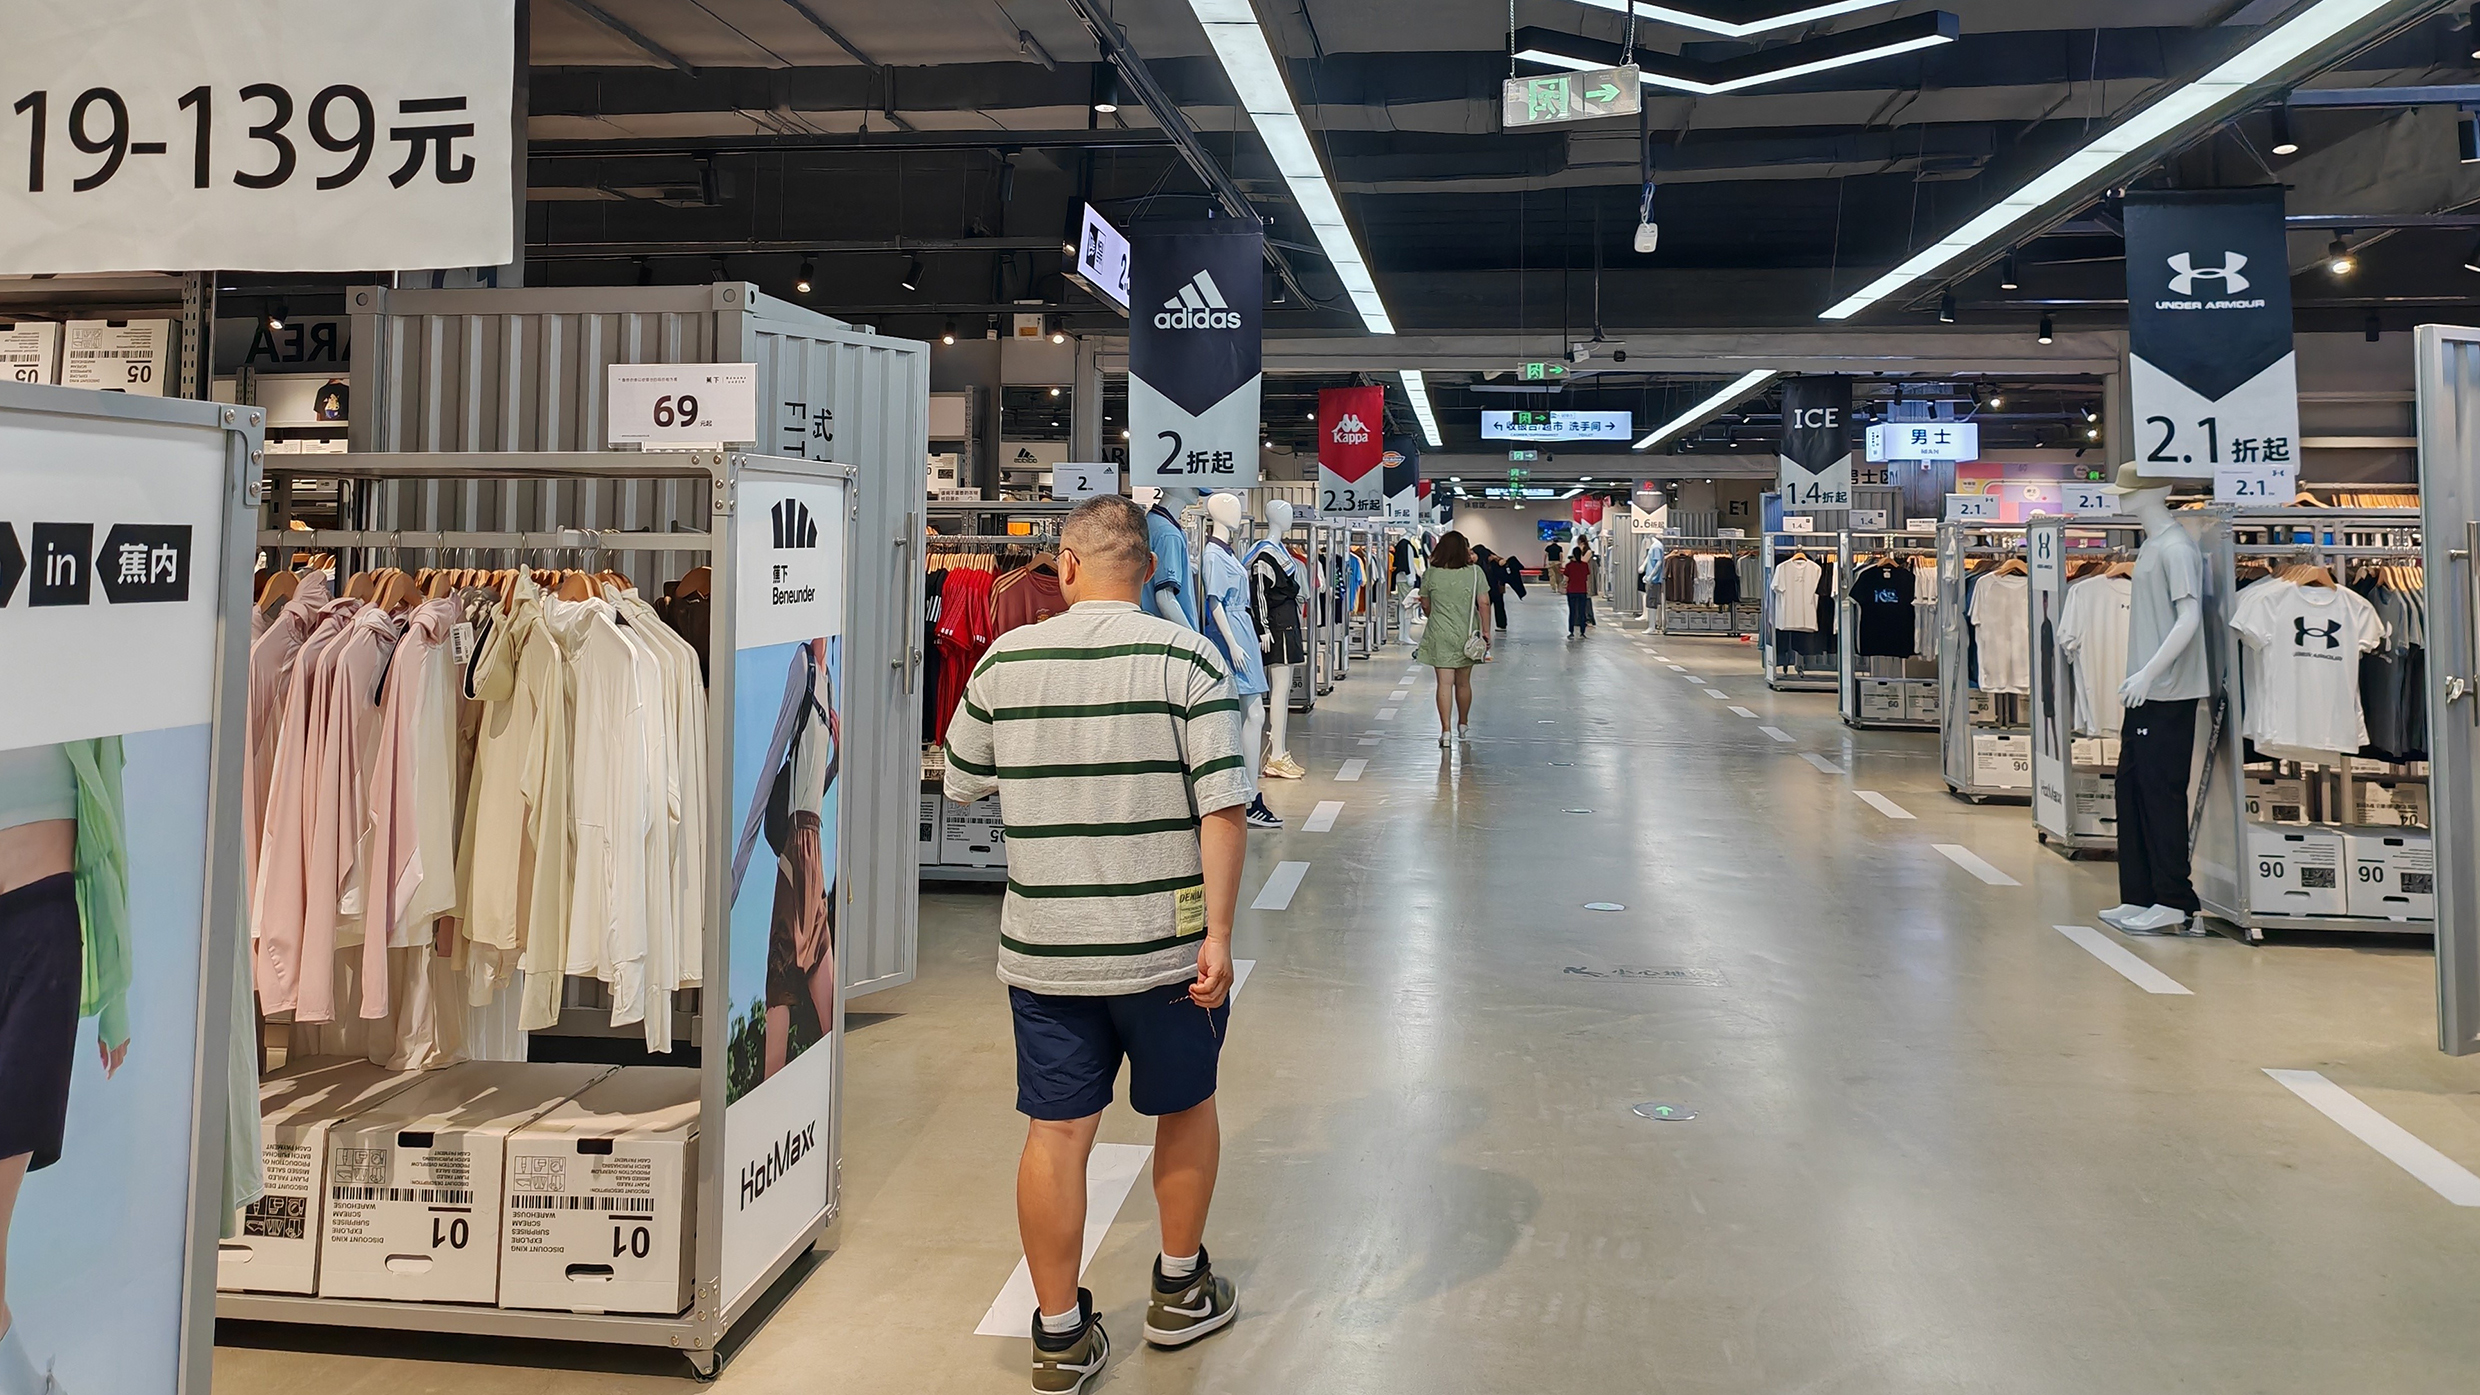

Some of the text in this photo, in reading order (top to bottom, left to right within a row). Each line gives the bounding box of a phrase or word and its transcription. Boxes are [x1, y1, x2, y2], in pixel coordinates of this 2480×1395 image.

[13, 82, 476, 193] 19-139元
[2155, 298, 2266, 310] UNDER ARMOUR
[1154, 307, 1242, 331] adidas
[127, 365, 152, 383] 05
[1793, 407, 1840, 429] ICE
[1568, 421, 1602, 432] 洗手间
[1334, 431, 1369, 445] Kappa
[1911, 428, 1952, 445] 男士
[2146, 416, 2290, 464] 2.1折起
[1157, 430, 1235, 475] 2折起
[1077, 476, 1088, 491] 2
[2235, 479, 2266, 496] 2.1
[1323, 489, 1381, 512] 2.3折起
[1787, 481, 1848, 505] 1.4折起
[1729, 500, 1748, 516] E1
[2079, 495, 2103, 508] 2.1
[1961, 504, 1981, 515] 2.1
[1860, 517, 1874, 525] 1.4
[45, 542, 179, 587] in 蕉内
[772, 585, 816, 606] Beneunder
[277, 1183, 309, 1191] DISCOUNT
[333, 1202, 377, 1210] WAREHOUSE
[332, 1210, 362, 1218] SCREAM
[512, 1211, 556, 1219] WAREHOUSE
[332, 1219, 370, 1227] SURPRISES
[331, 1227, 363, 1235] EXPLORE
[431, 1217, 469, 1250] 01
[511, 1228, 550, 1236] SURPRISES
[331, 1235, 384, 1244] DISCOUNT KING
[612, 1225, 651, 1259] 01
[510, 1245, 565, 1253] DISCOUNT KING
